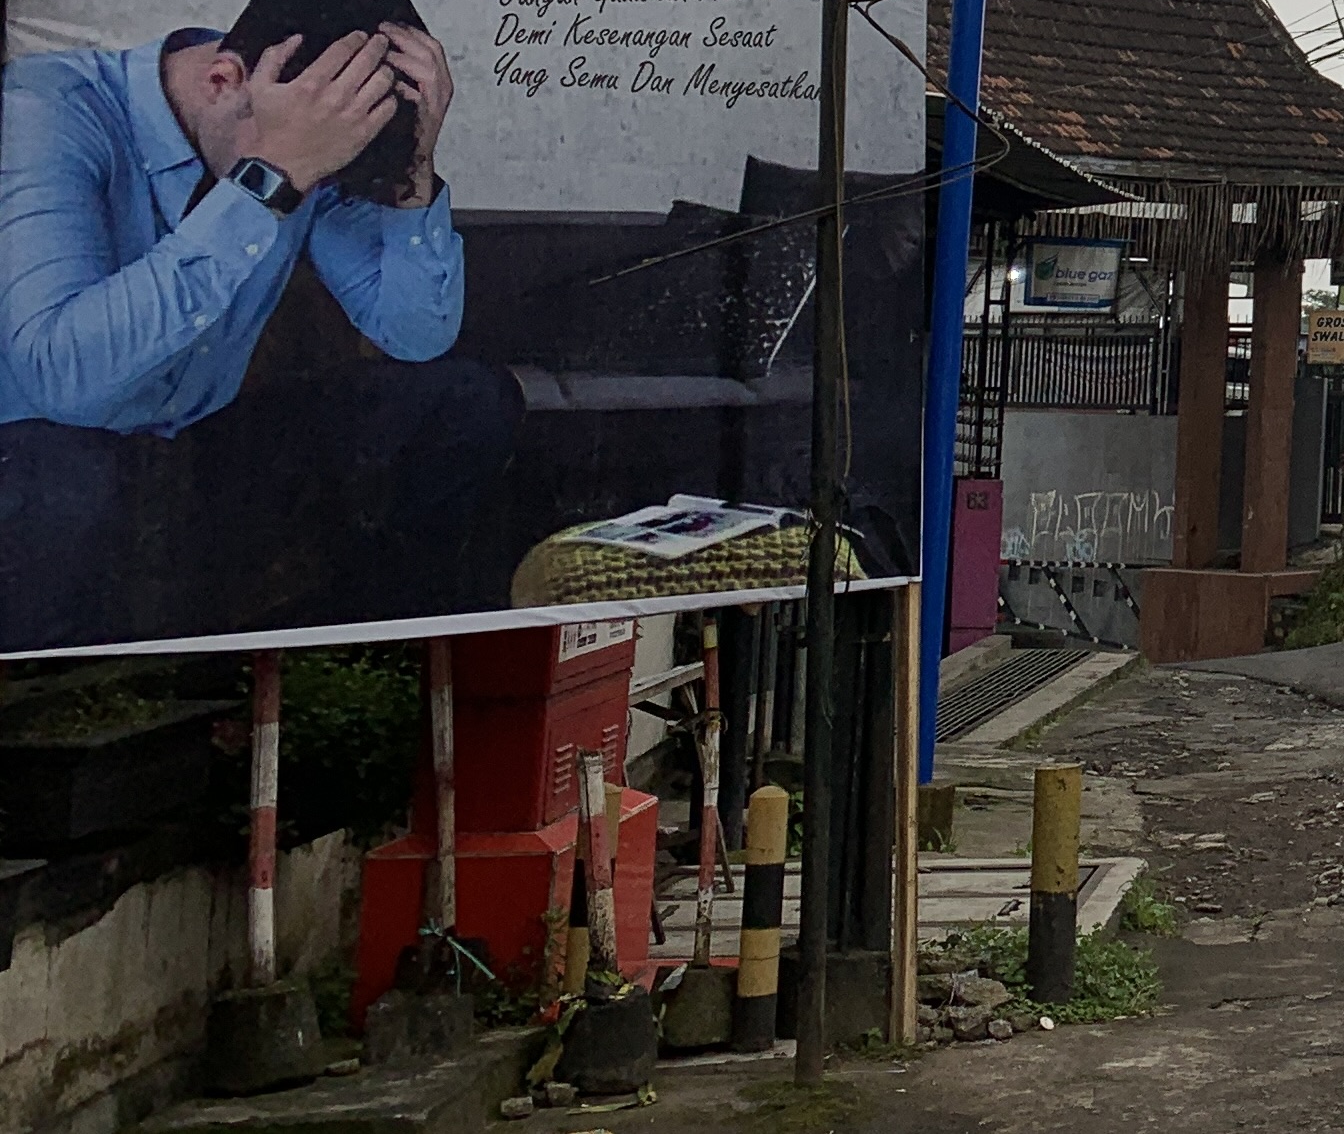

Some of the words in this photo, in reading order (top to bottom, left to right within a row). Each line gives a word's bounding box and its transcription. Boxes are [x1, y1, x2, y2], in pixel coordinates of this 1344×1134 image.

[494, 12, 557, 47] Demi
[563, 12, 692, 58] Kesenangan
[703, 16, 778, 48] Sesaat
[493, 52, 549, 97] Yang
[560, 56, 620, 90] Semu
[631, 61, 675, 95] Dan
[1055, 267, 1086, 280] blue
